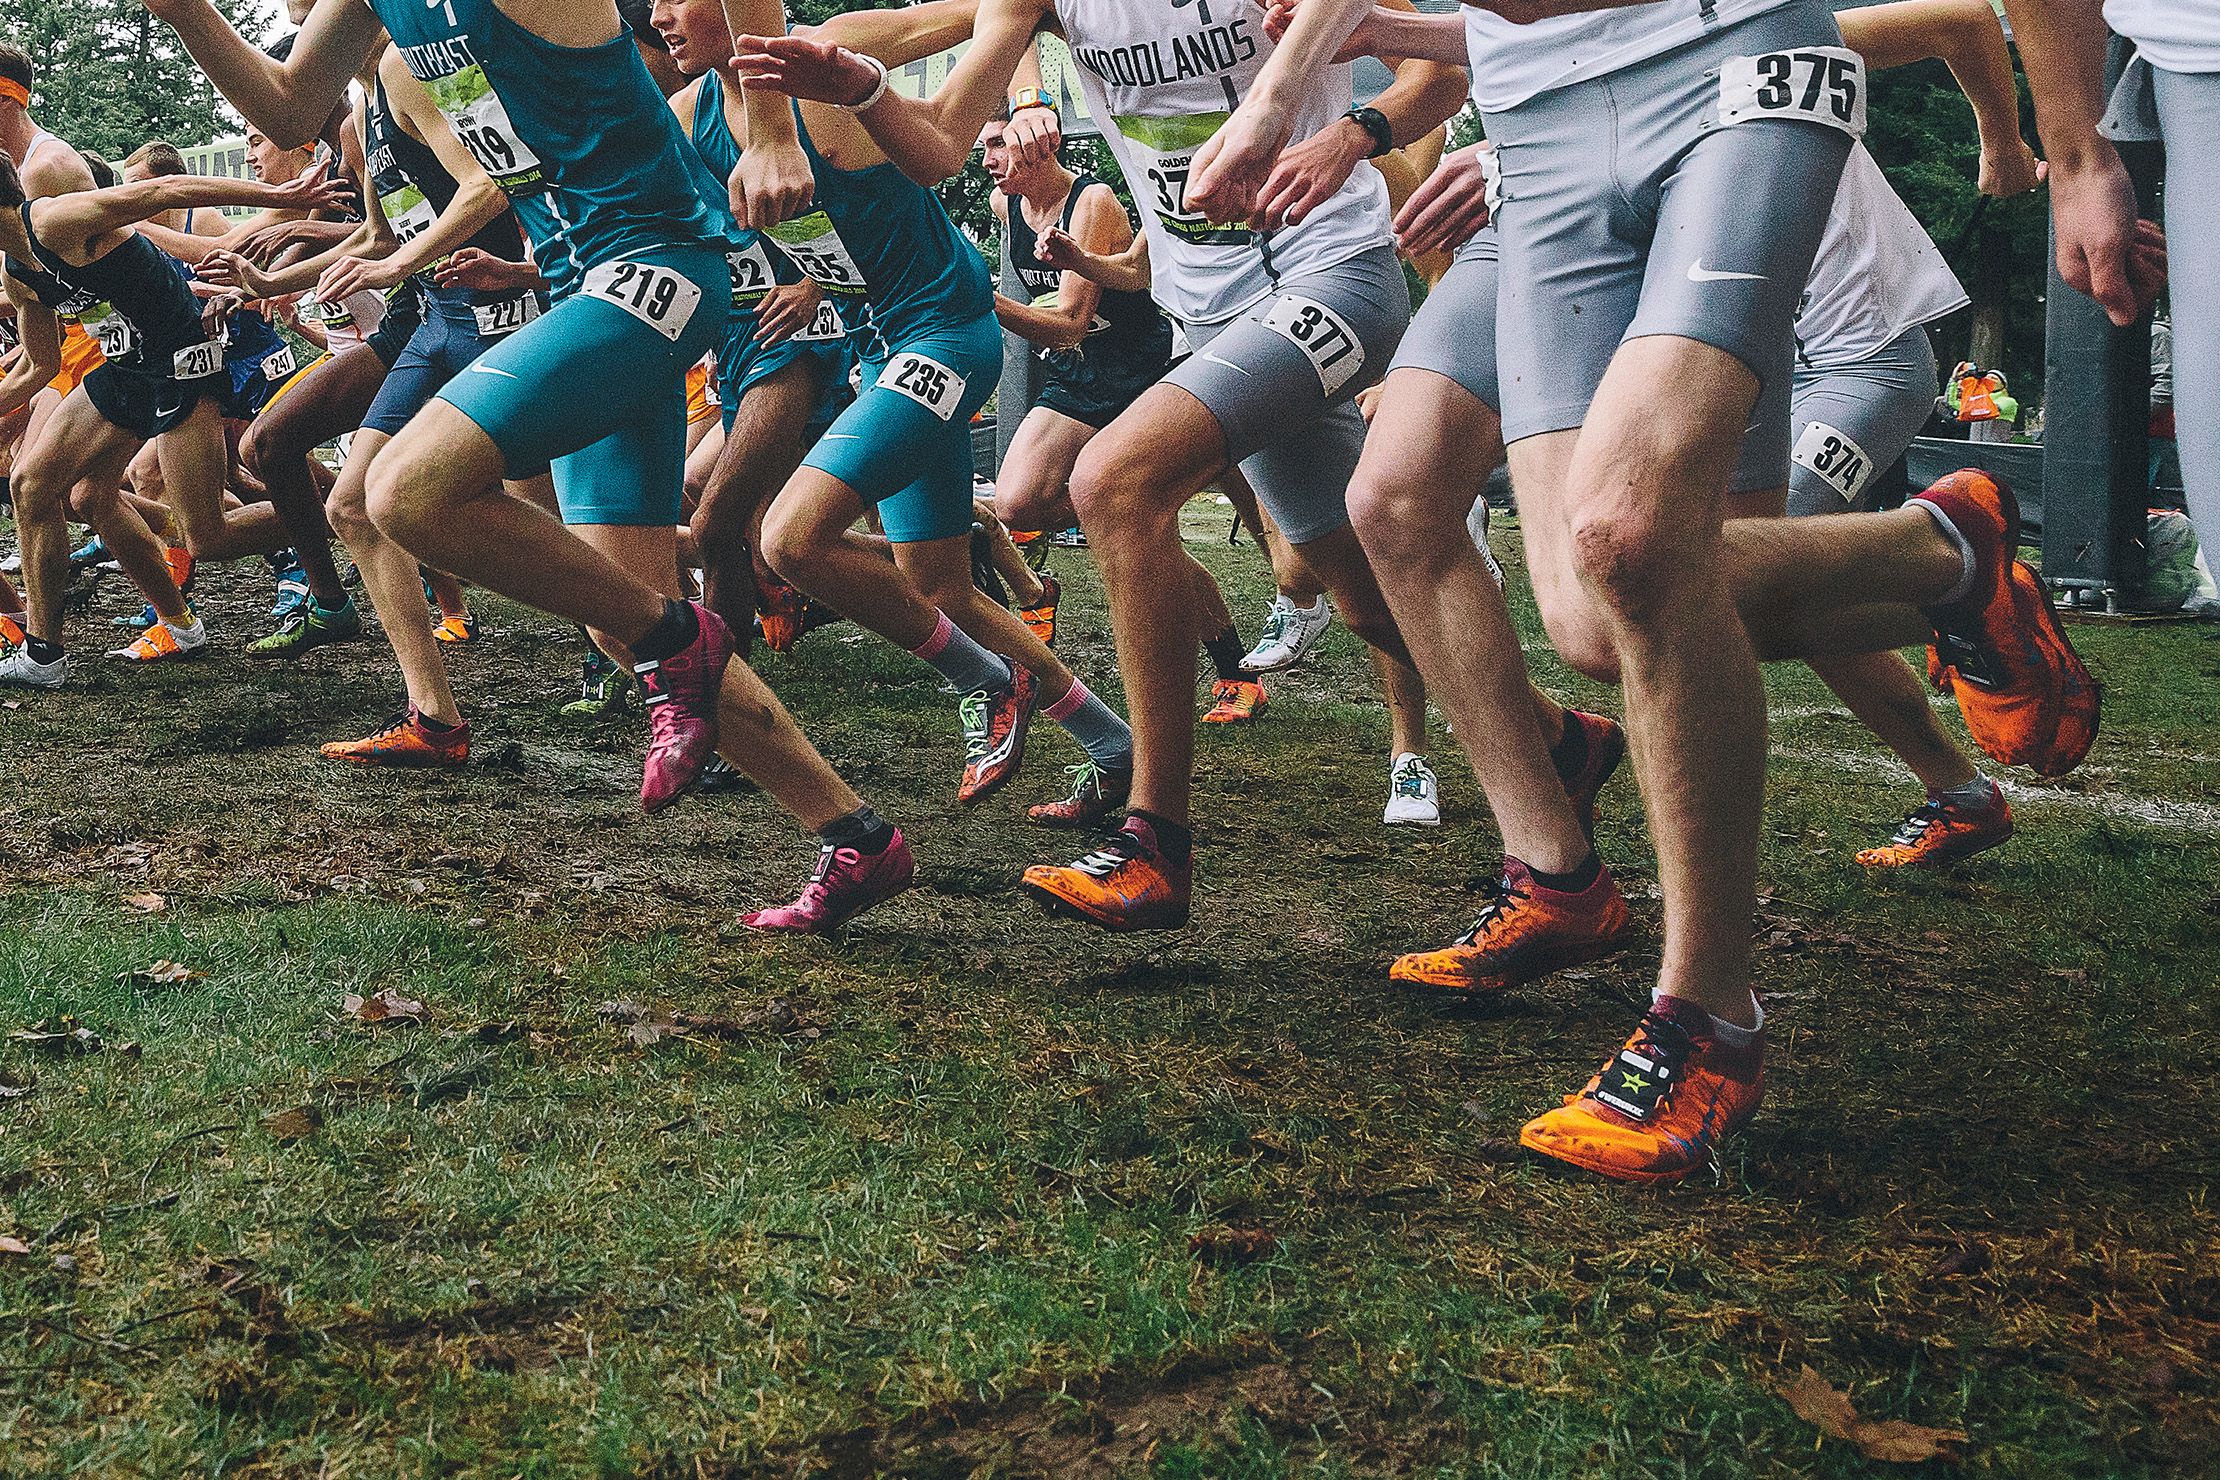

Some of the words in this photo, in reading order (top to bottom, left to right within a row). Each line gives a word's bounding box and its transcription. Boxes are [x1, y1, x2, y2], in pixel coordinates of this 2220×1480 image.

[1075, 19, 1256, 87] WOODLANDS
[1755, 53, 1857, 122] 375
[1148, 168, 1190, 215] 37
[605, 263, 677, 320] 219
[728, 258, 765, 289] 32
[490, 297, 527, 328] 227
[1289, 305, 1354, 369] 377
[187, 347, 214, 375] 231
[271, 351, 291, 375] 247
[894, 359, 948, 406] 235
[1814, 435, 1865, 491] 374
